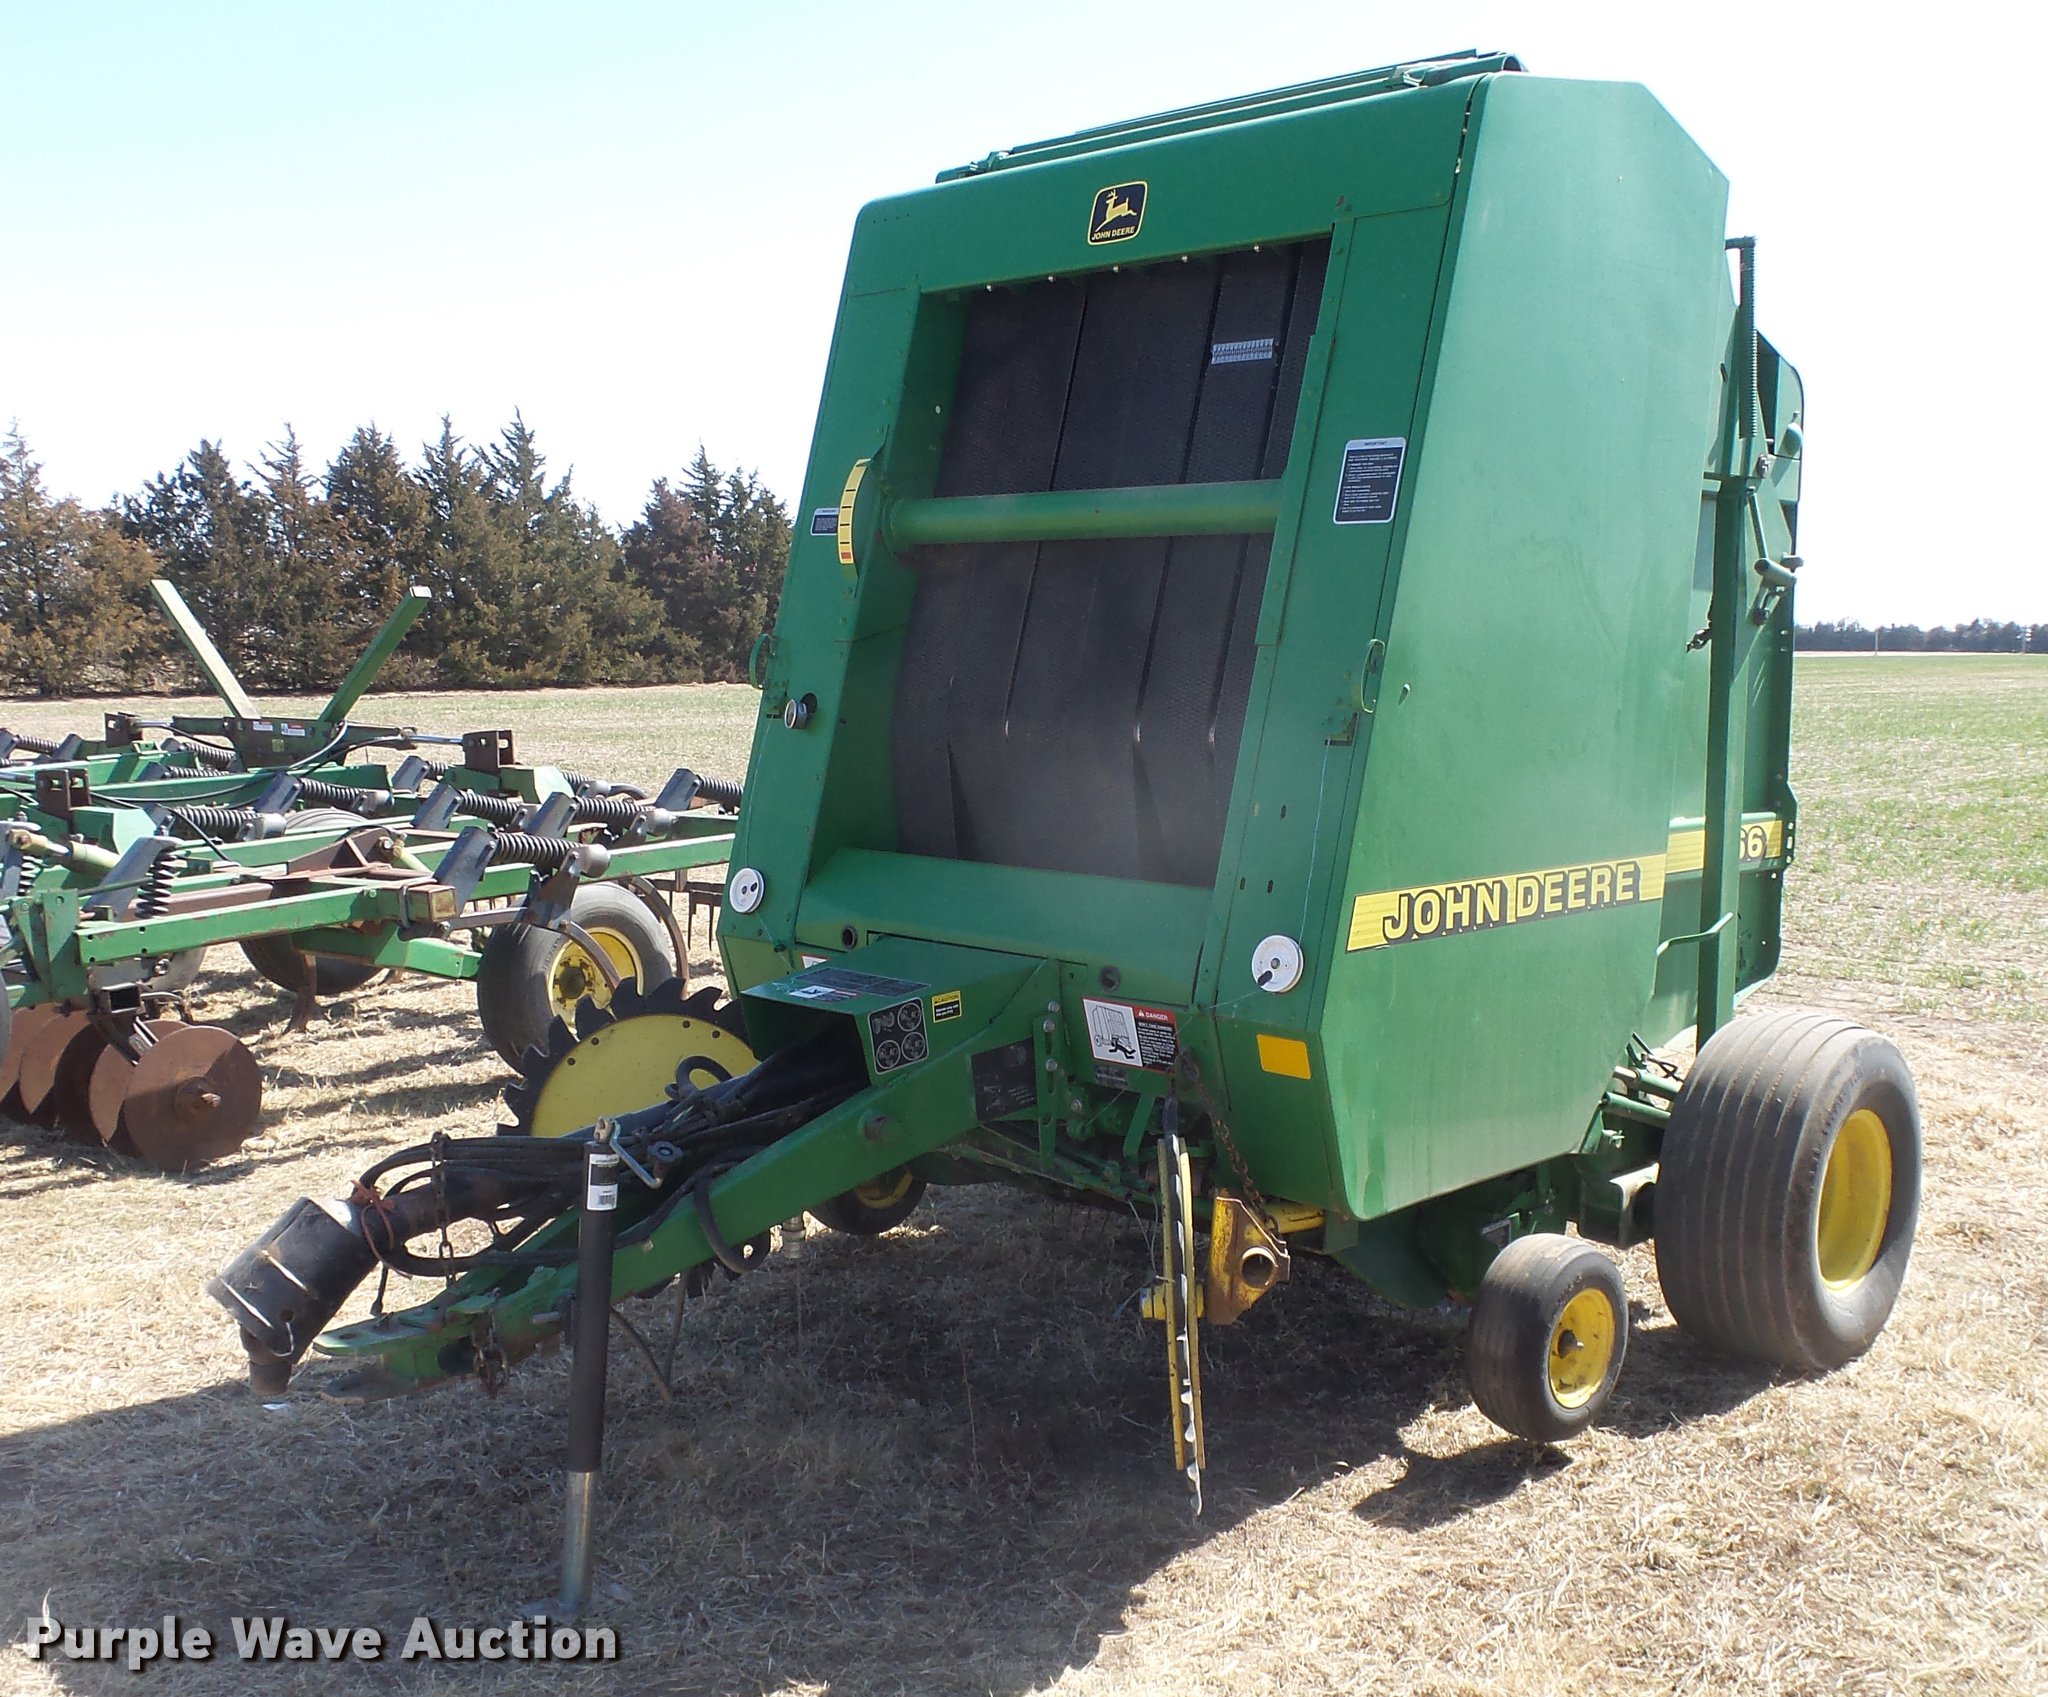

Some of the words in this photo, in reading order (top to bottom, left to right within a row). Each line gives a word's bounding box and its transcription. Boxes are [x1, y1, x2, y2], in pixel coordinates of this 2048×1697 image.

[1091, 230, 1110, 241] JOHN
[1112, 226, 1135, 236] DEERE
[1383, 880, 1509, 944] JOHN
[1515, 860, 1641, 918] DEERE
[1145, 1012, 1169, 1021] DANGER
